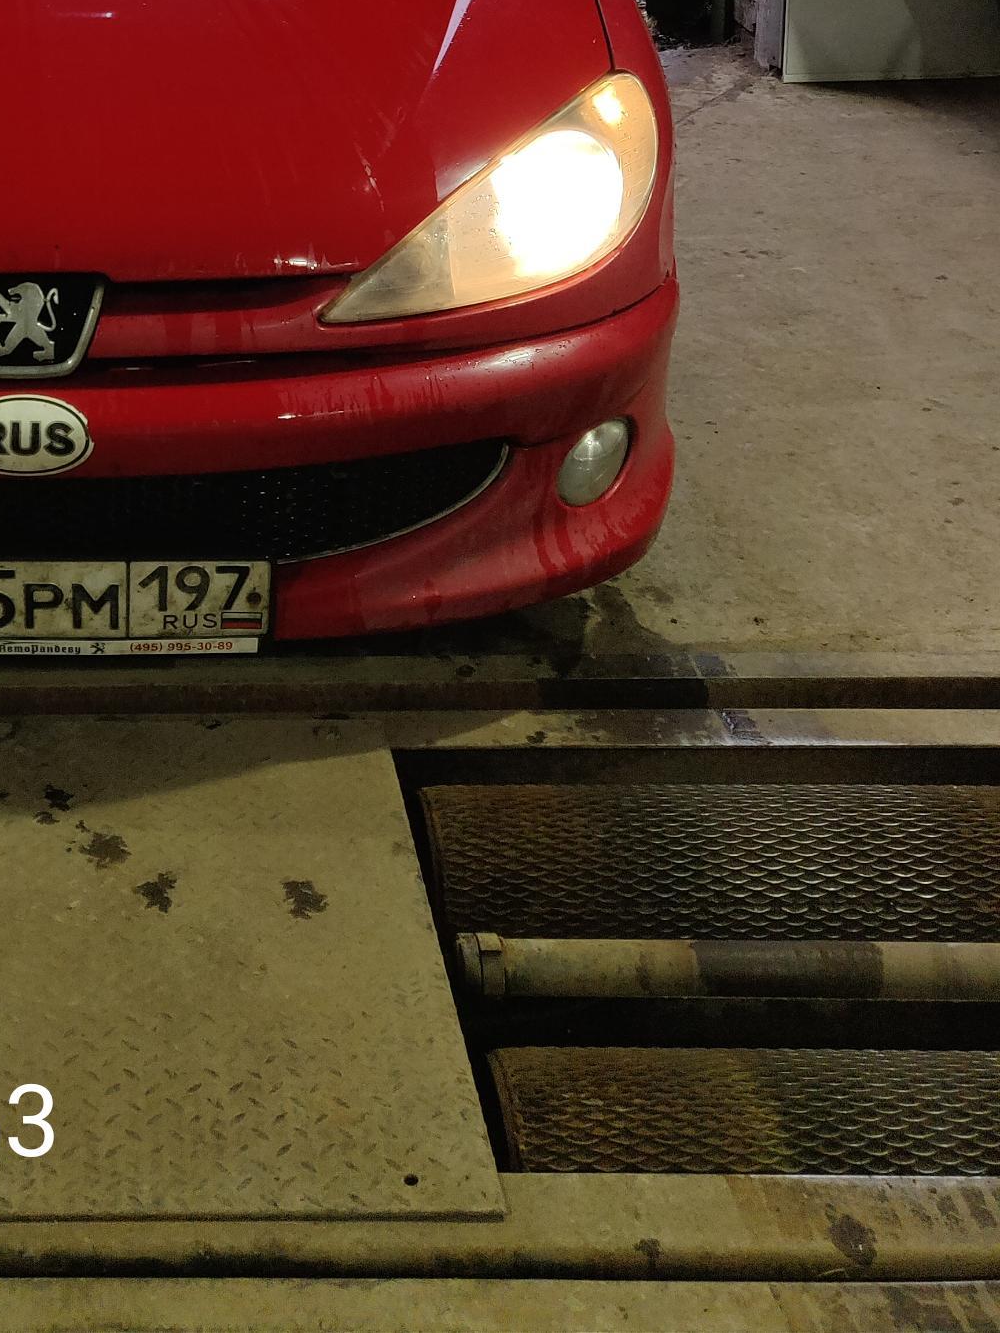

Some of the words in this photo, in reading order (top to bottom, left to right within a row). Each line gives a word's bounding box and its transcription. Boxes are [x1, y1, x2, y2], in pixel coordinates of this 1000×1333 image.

[138, 565, 251, 612] 197
[162, 613, 218, 630] RUS
[130, 641, 163, 652] (495)
[167, 641, 233, 652] 995-30-89
